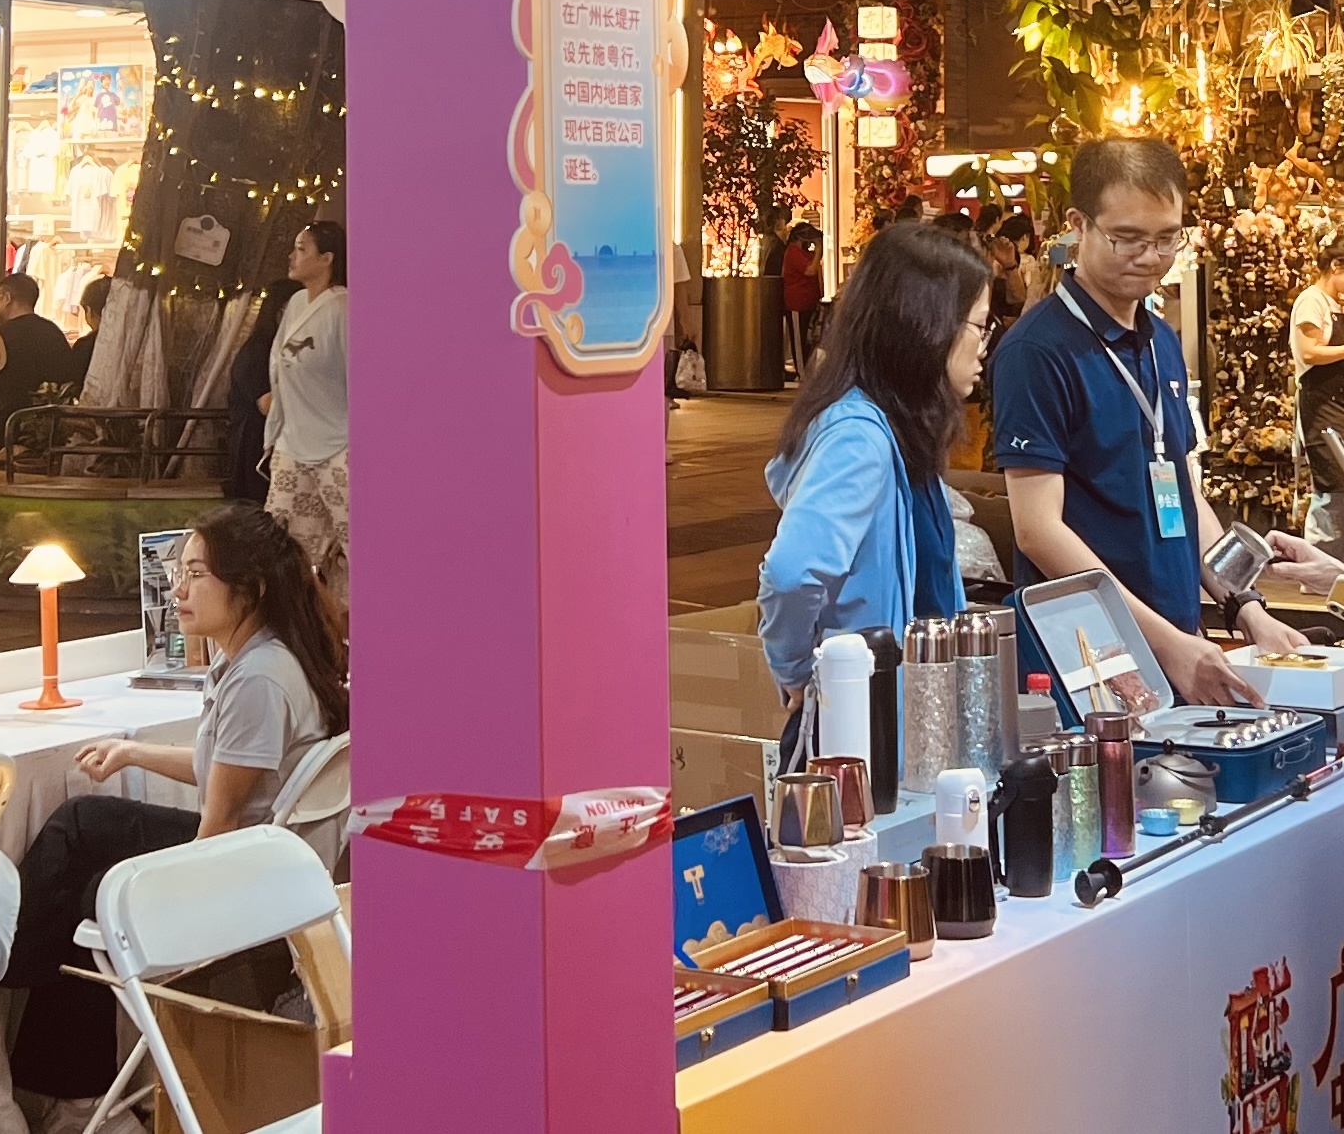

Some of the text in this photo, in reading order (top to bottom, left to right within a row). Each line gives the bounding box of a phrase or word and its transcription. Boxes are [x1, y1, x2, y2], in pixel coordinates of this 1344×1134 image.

[561, 2, 641, 32] 在广州长堤开
[563, 82, 643, 107] 中国内地首家
[564, 121, 643, 146] 现代百货公司
